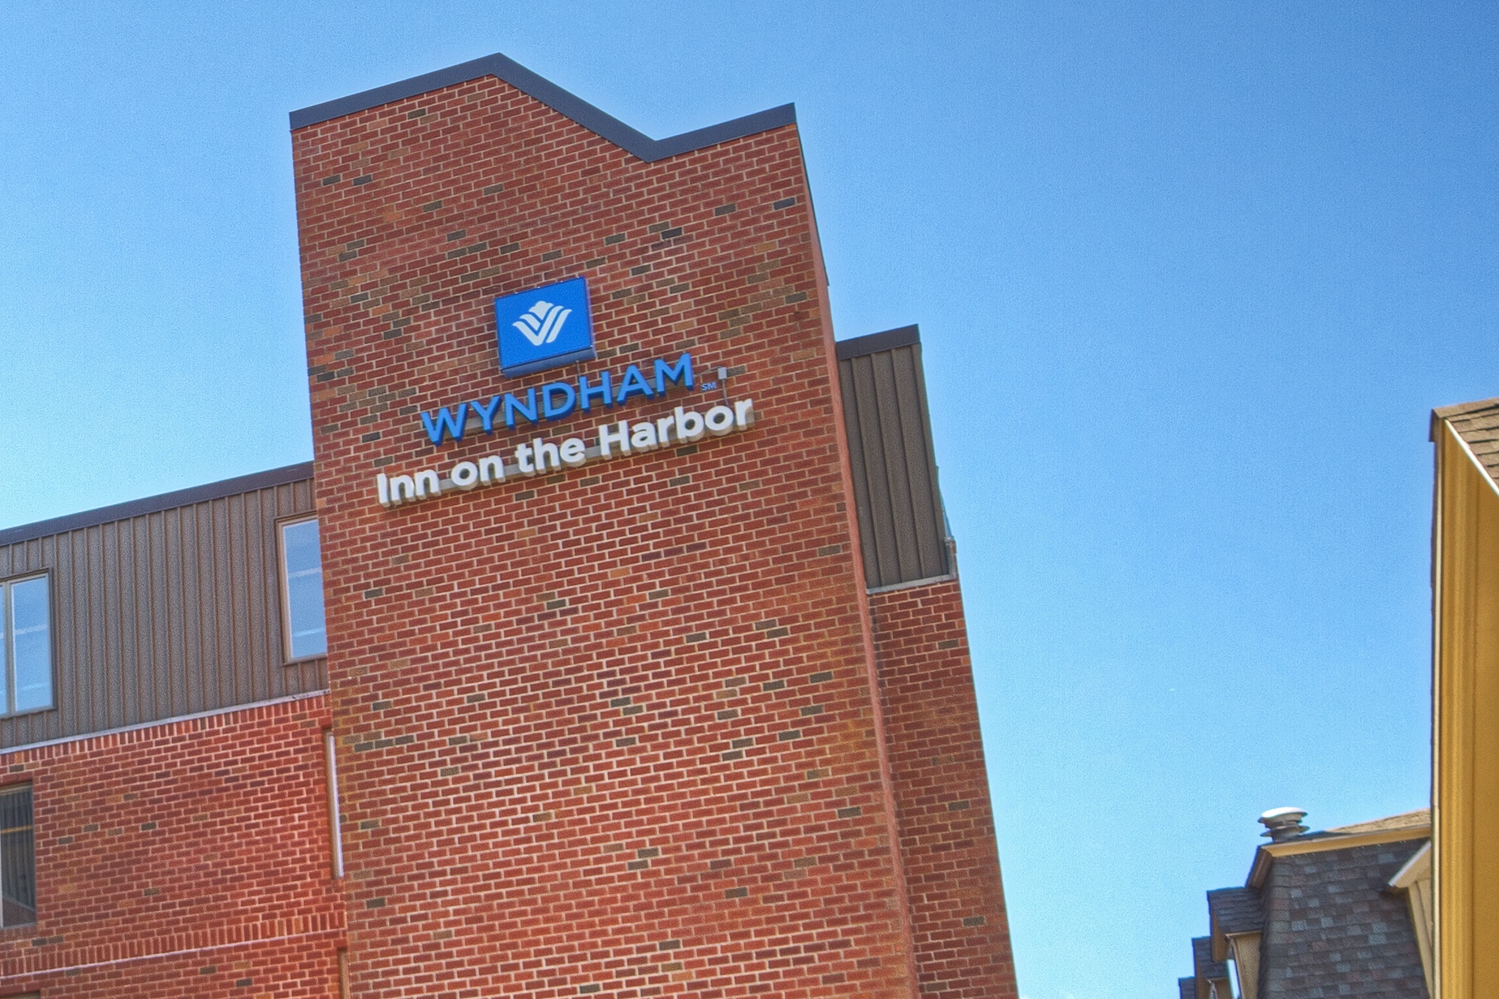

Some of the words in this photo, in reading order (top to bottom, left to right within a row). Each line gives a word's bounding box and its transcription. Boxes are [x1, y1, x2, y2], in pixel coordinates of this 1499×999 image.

[420, 353, 694, 447] WYNDHAM
[700, 381, 717, 393] SM
[377, 468, 441, 508] Inn
[451, 453, 505, 490] on
[514, 437, 587, 477] the
[598, 398, 755, 460] Harbor
